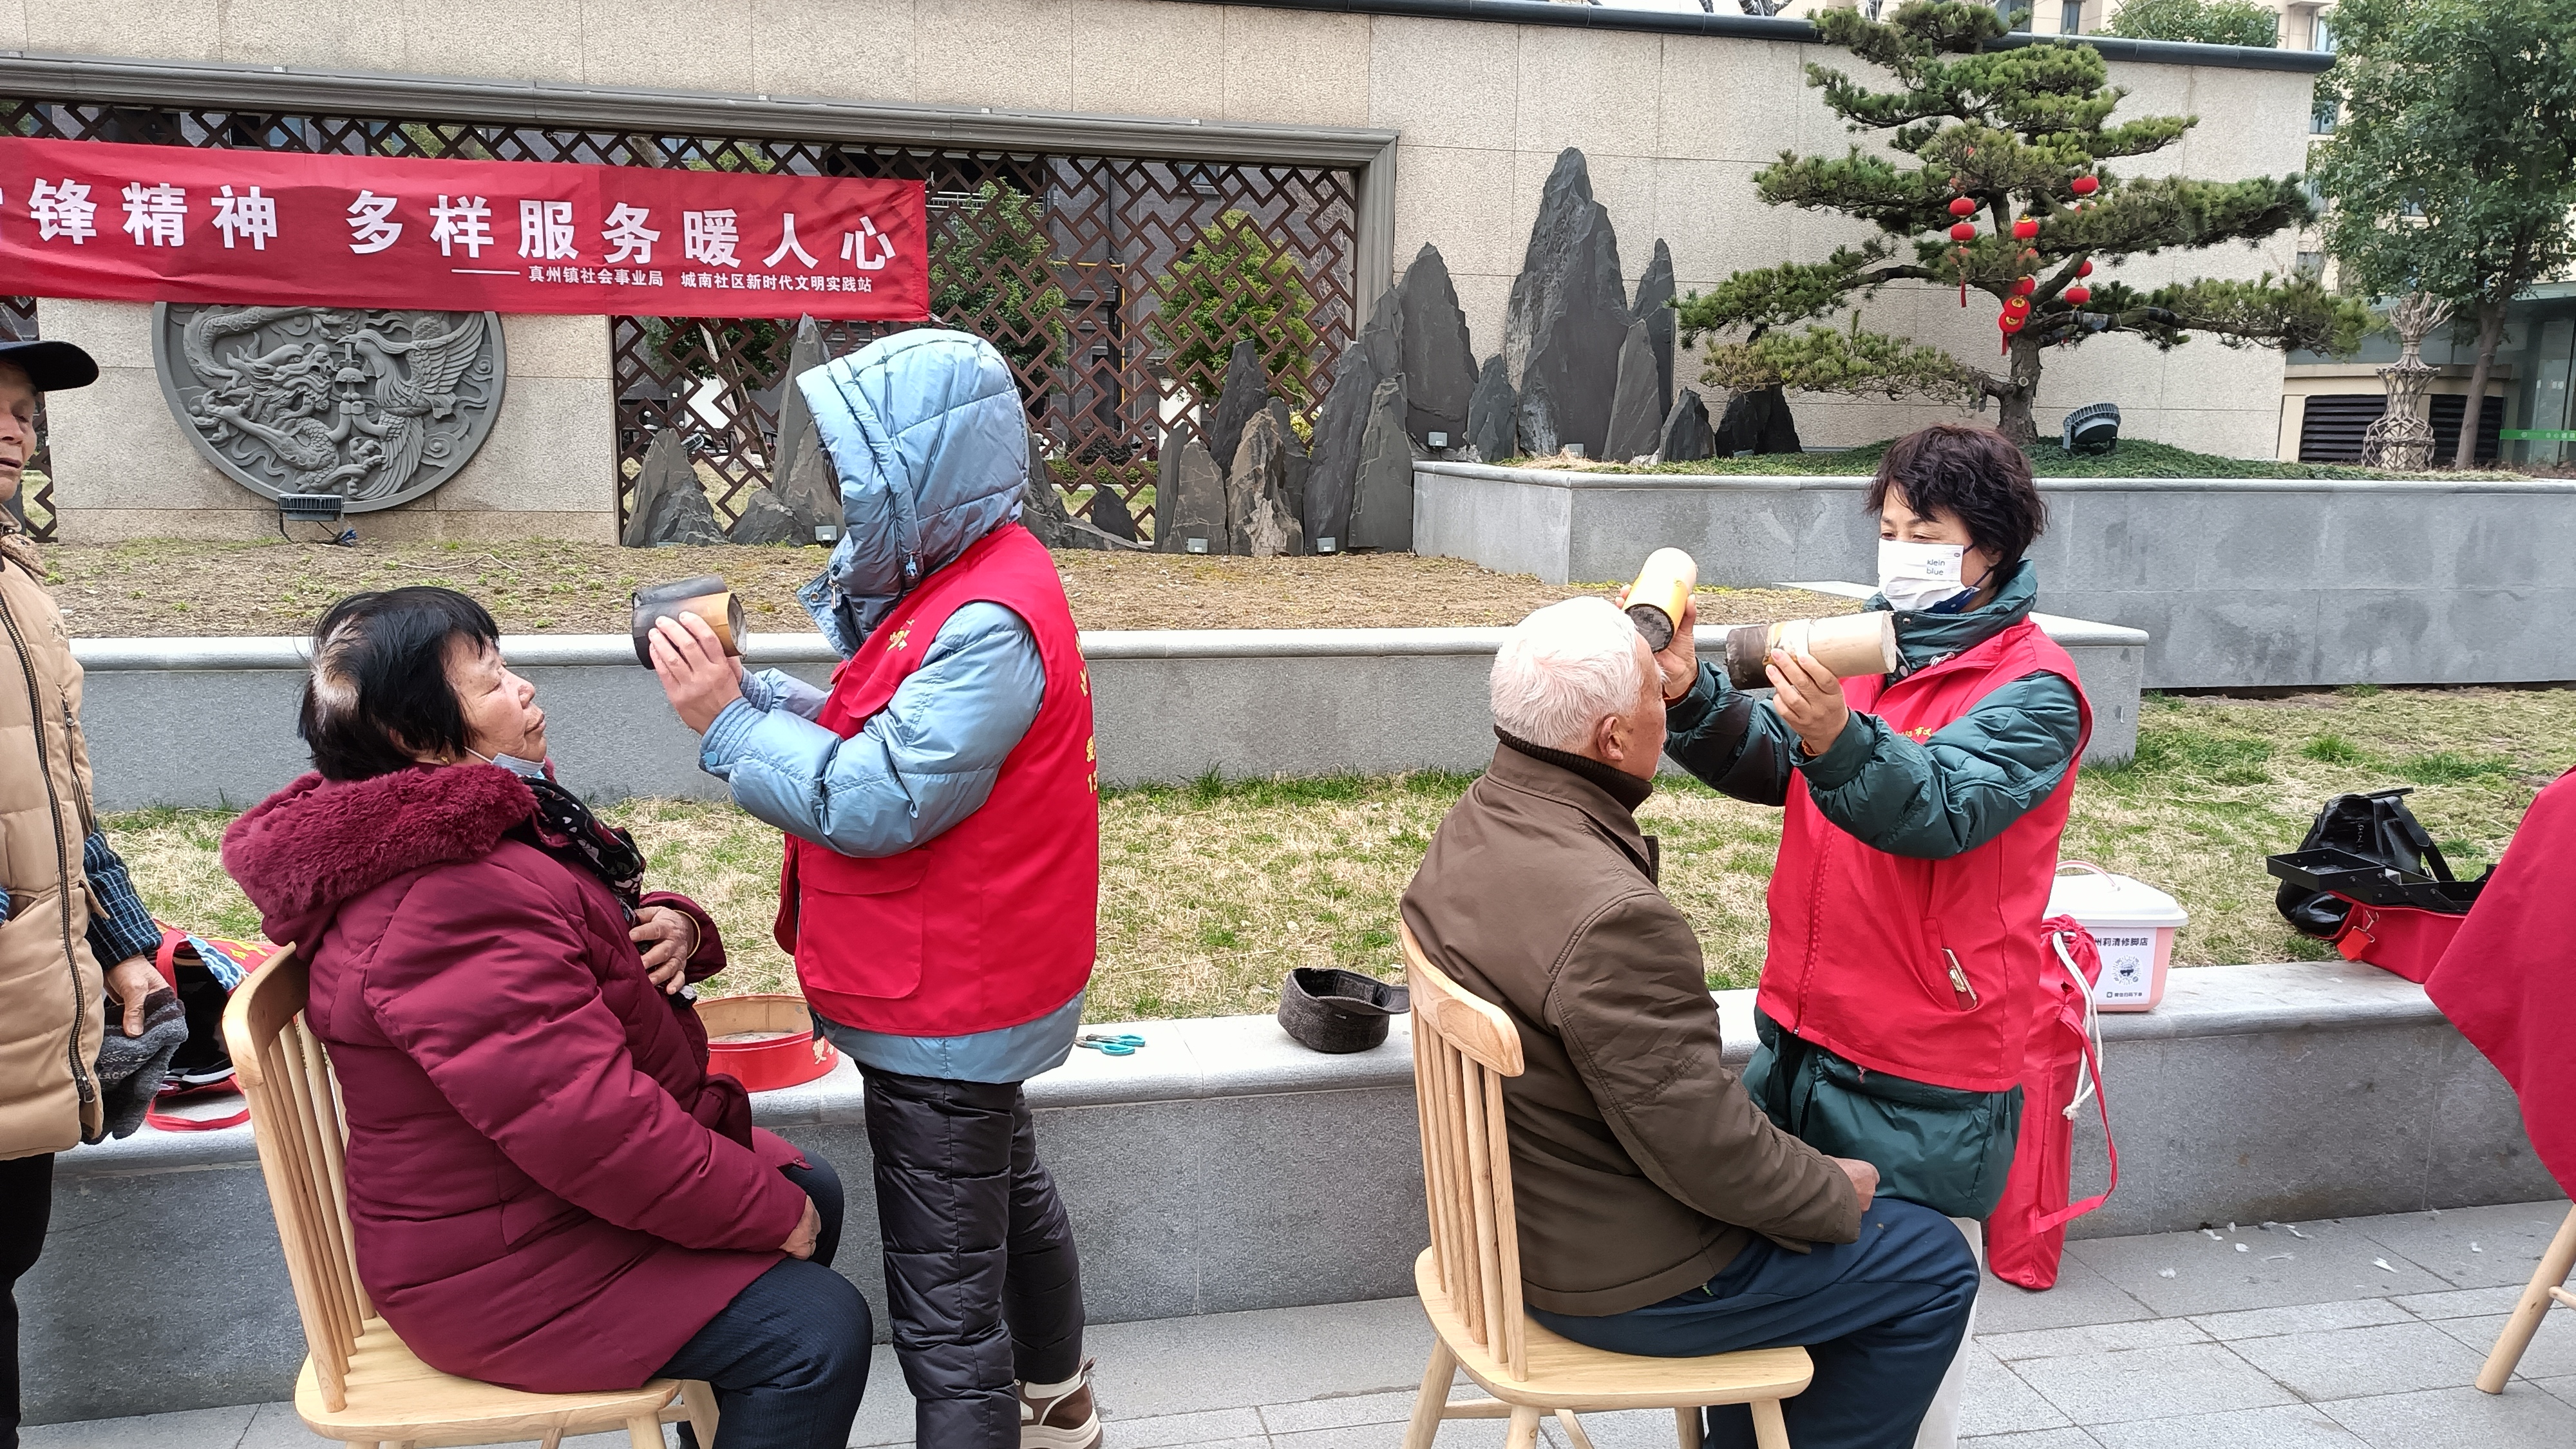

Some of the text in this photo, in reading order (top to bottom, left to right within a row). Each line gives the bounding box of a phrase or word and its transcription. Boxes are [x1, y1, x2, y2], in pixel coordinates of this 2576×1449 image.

[0, 177, 896, 271] 锋精神 多样服务暖人心
[528, 265, 873, 293] 真州镇社会事业局 城南社区新时代文明实践站
